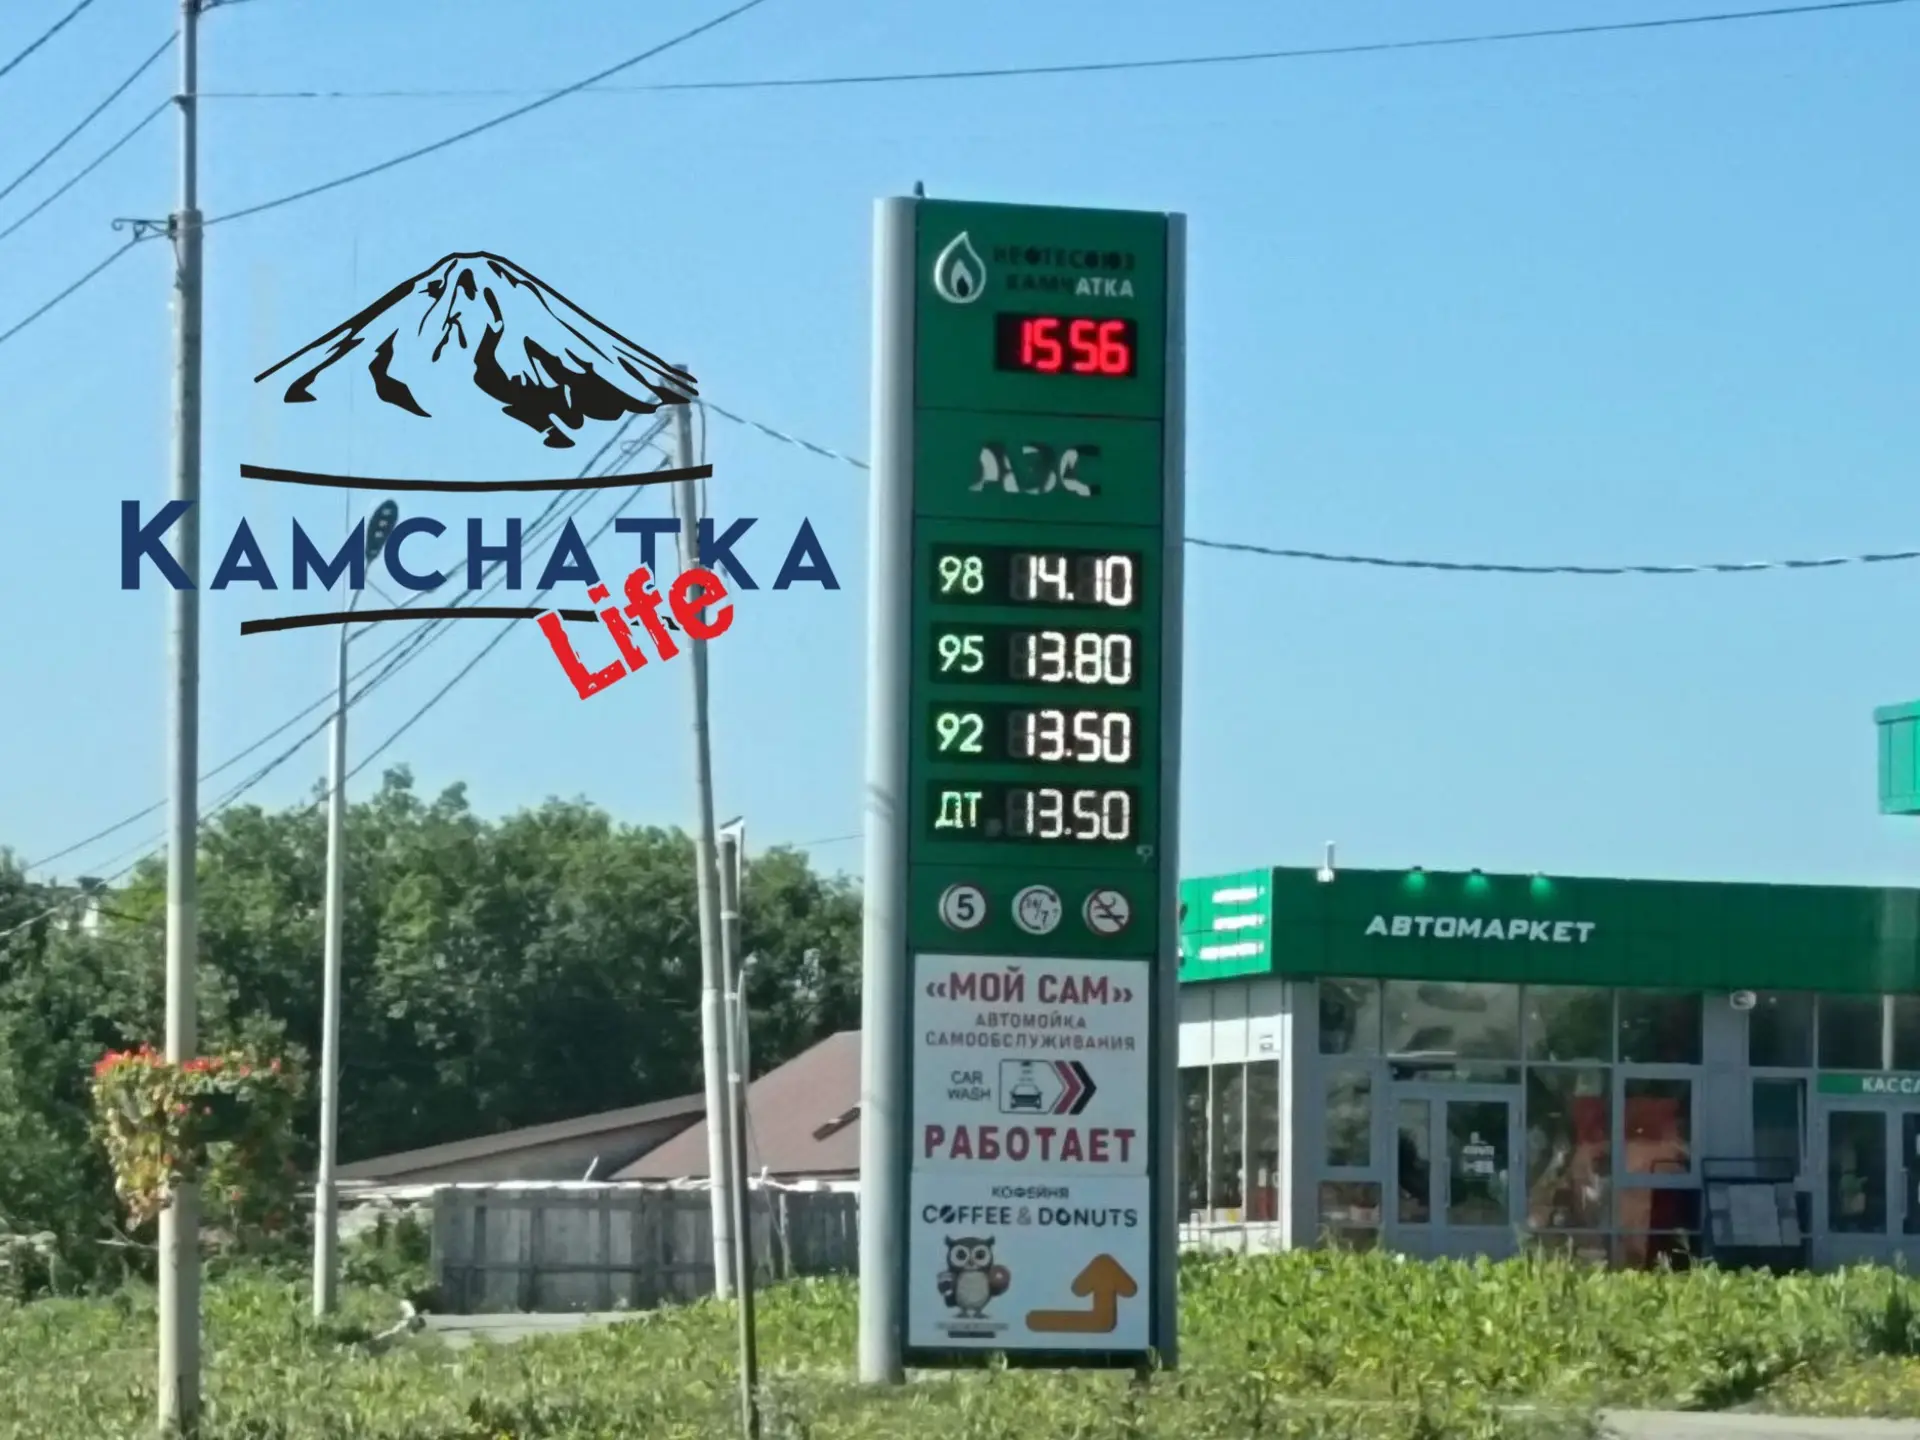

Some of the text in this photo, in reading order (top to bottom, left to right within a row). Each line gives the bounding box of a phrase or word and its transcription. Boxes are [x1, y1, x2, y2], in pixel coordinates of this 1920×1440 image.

[938, 555, 1132, 606] 98 14.10
[938, 631, 1132, 685] 95 13.80
[936, 709, 1131, 763] 92 13.50
[934, 788, 1130, 840] ДТ 13.50
[956, 894, 975, 921] 5
[1364, 914, 1596, 943] АВТОМАРКЕТ
[975, 1011, 1087, 1029] АВТОМОЙКА
[925, 1031, 1136, 1051] САМООБСЛУЖИВАНИЯ
[951, 1070, 983, 1085] CAR
[947, 1086, 991, 1101] WASH
[924, 1124, 1136, 1163] РАБОТАЕТ
[991, 1184, 1070, 1200] КОФЕЙНЯ
[922, 1204, 1138, 1228] COFFEE & DONUTS
